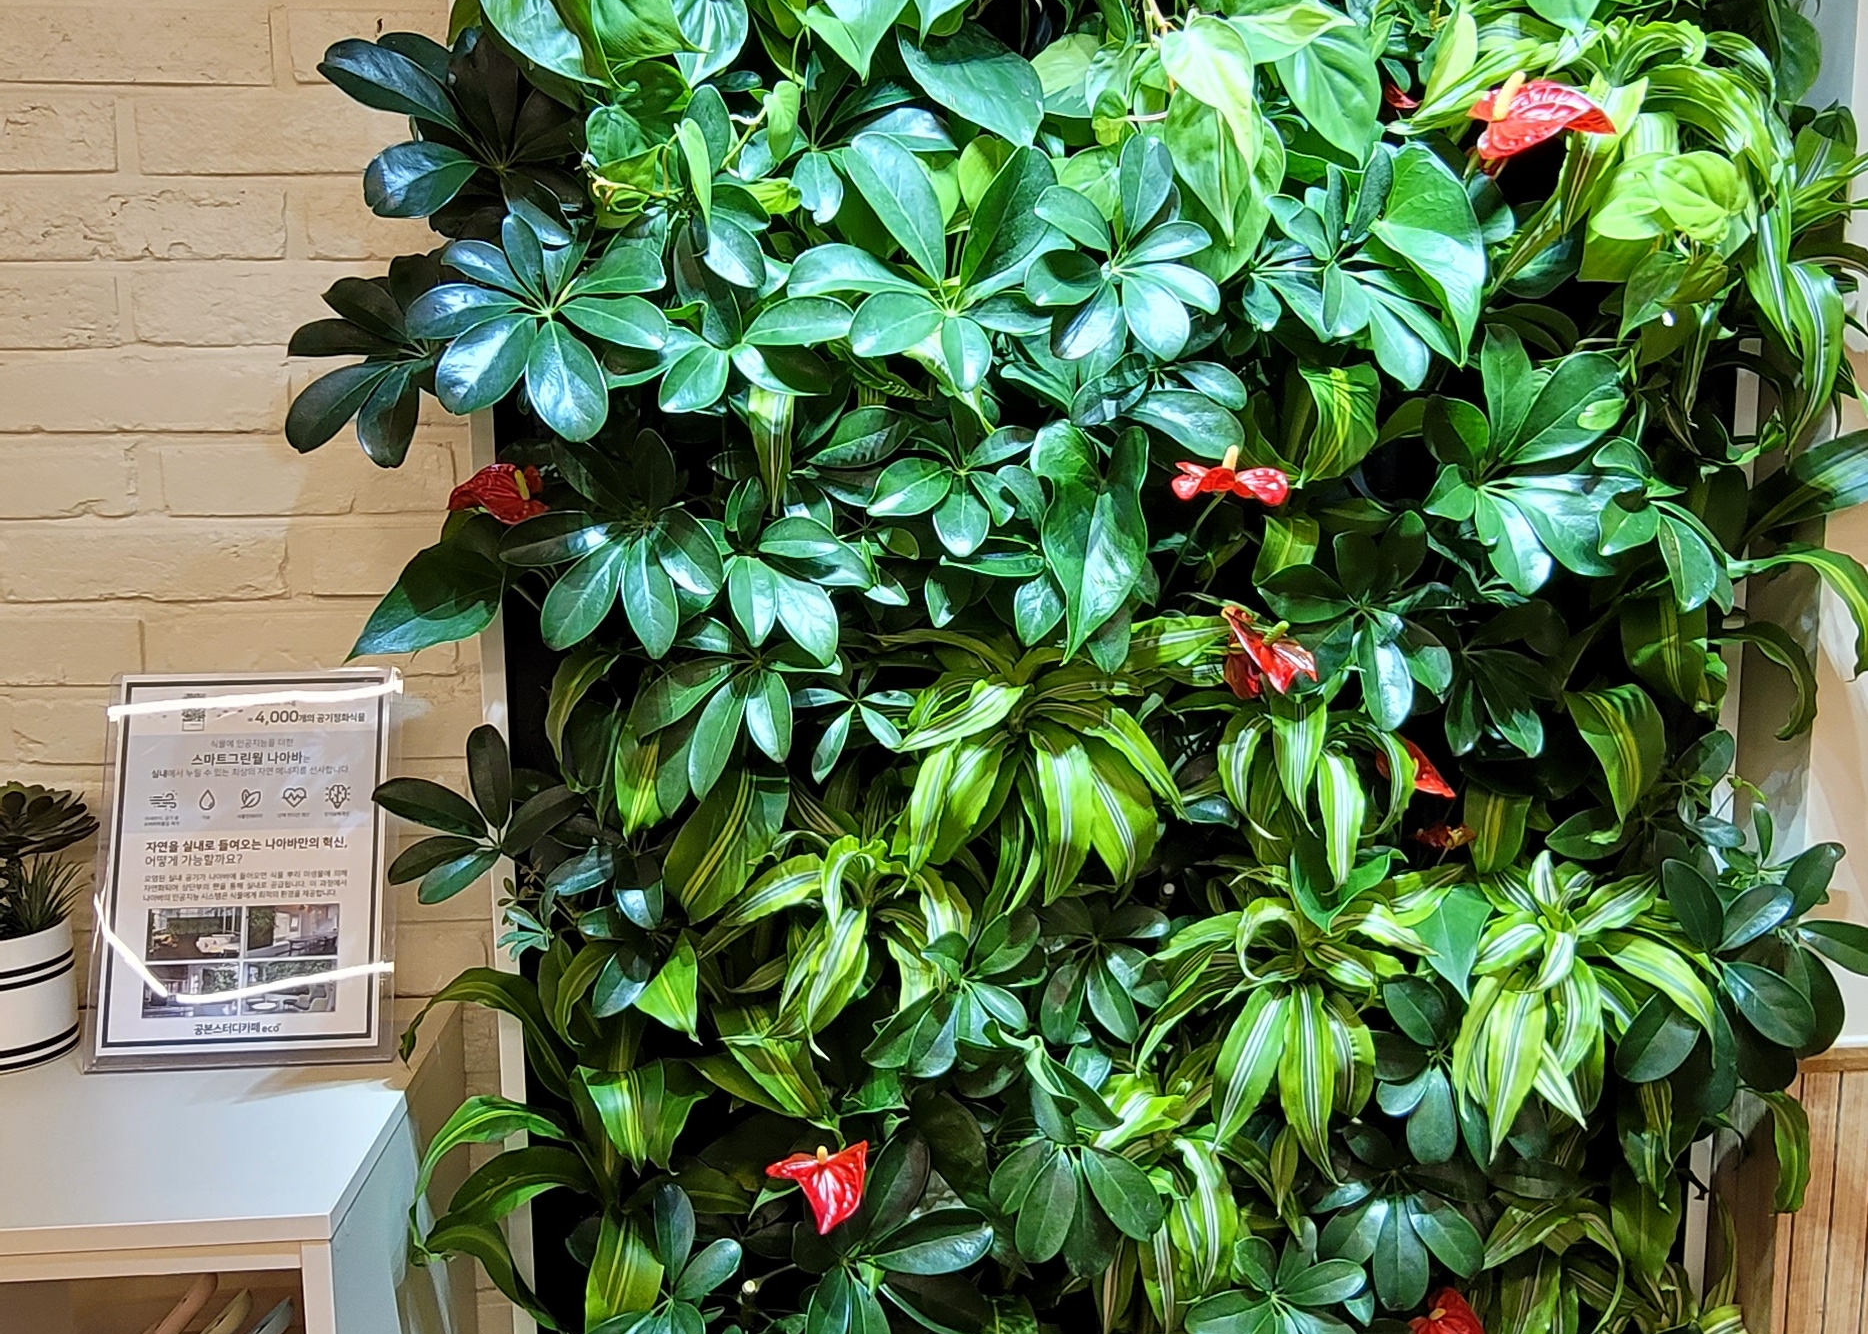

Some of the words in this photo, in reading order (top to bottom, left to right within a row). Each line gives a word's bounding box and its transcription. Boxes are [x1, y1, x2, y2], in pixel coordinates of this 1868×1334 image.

[236, 738, 275, 748] 인공지능을
[191, 752, 264, 766] 스마트그린월
[267, 751, 311, 765] 나아바는
[152, 769, 184, 779] 실내에서
[204, 769, 212, 777] 수
[214, 768, 230, 777] 있는
[145, 840, 179, 854] 자연을
[182, 840, 216, 853] 실내로
[218, 838, 262, 851] 들여오는
[265, 836, 319, 850] 나아바만의
[322, 836, 348, 848] 혁신,
[145, 854, 179, 867] 어떻게
[181, 853, 243, 866] 가능할까요?
[168, 874, 183, 882] 실내
[194, 1021, 261, 1036] 공본스터디카페
